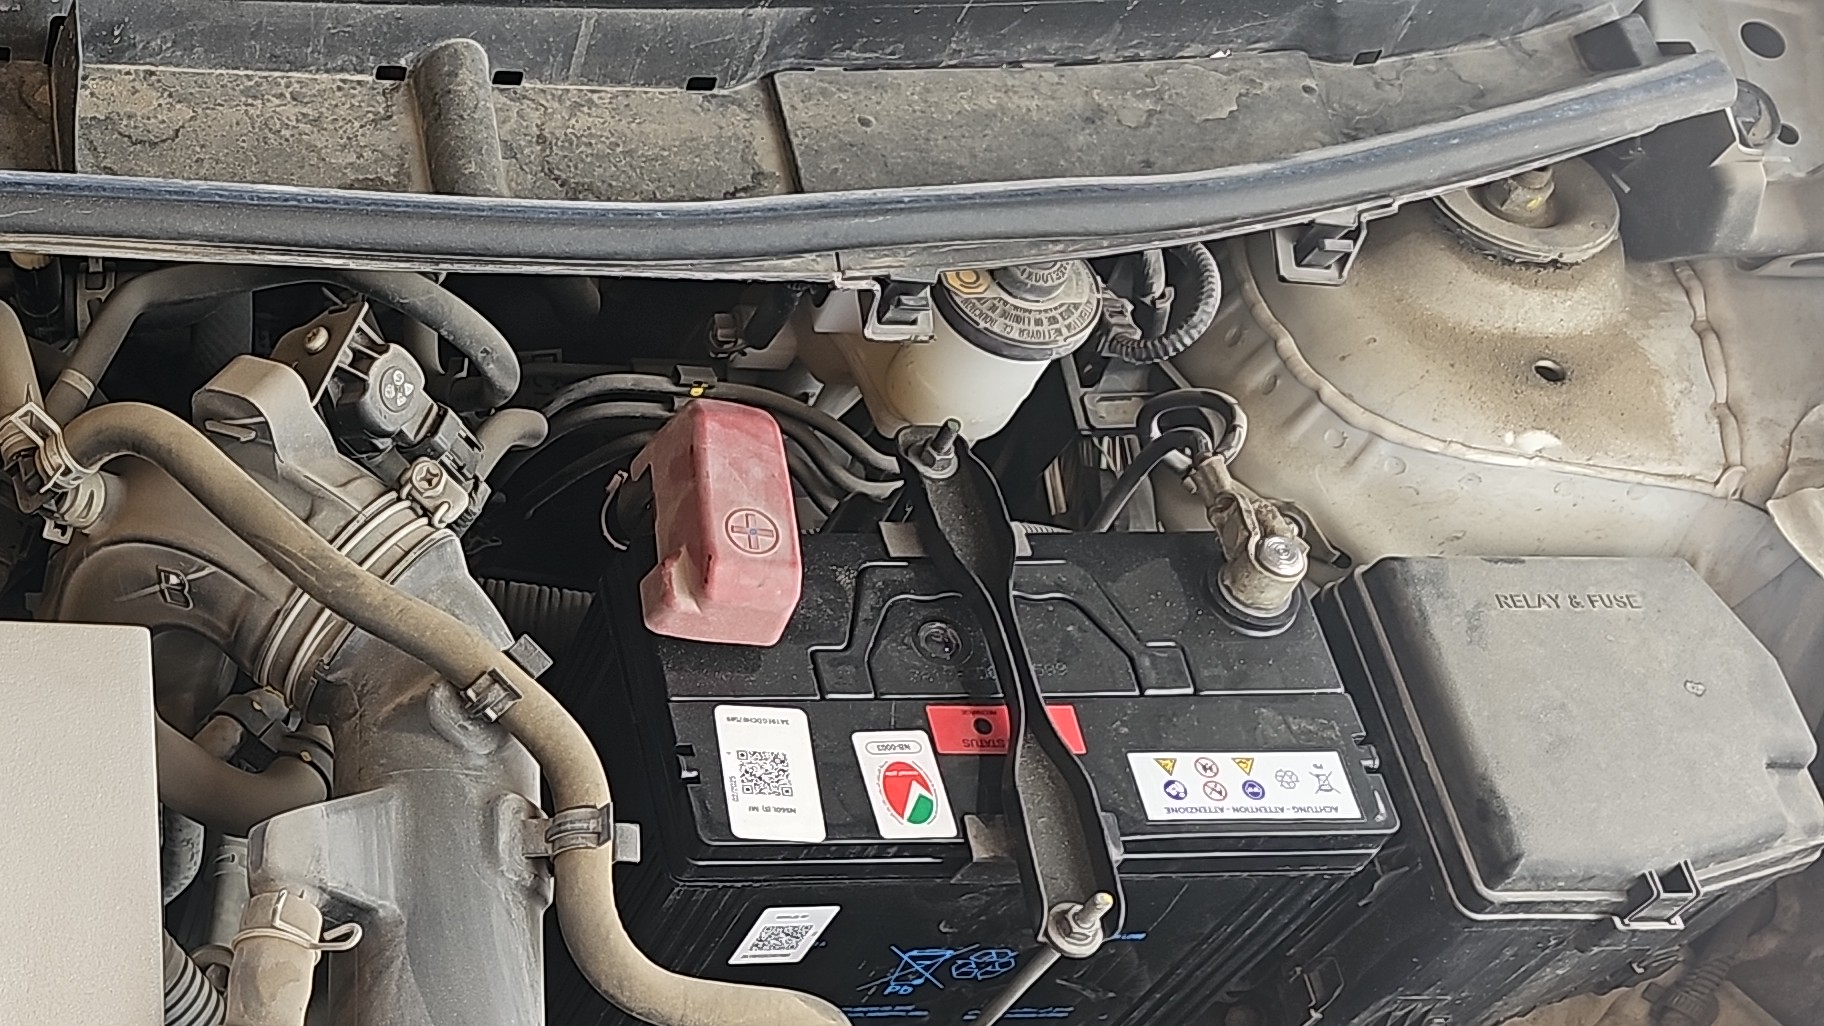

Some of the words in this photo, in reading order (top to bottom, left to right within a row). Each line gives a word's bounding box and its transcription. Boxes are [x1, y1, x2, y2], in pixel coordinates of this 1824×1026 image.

[1495, 592, 1561, 610] RELAY
[1568, 593, 1584, 610] &
[1587, 593, 1643, 610] FUSE
[962, 738, 1006, 749] STATUS
[1164, 805, 1225, 815] ATTENZIONE
[1231, 805, 1285, 814] ATTENTION
[1291, 805, 1339, 815] ACHTUNG
